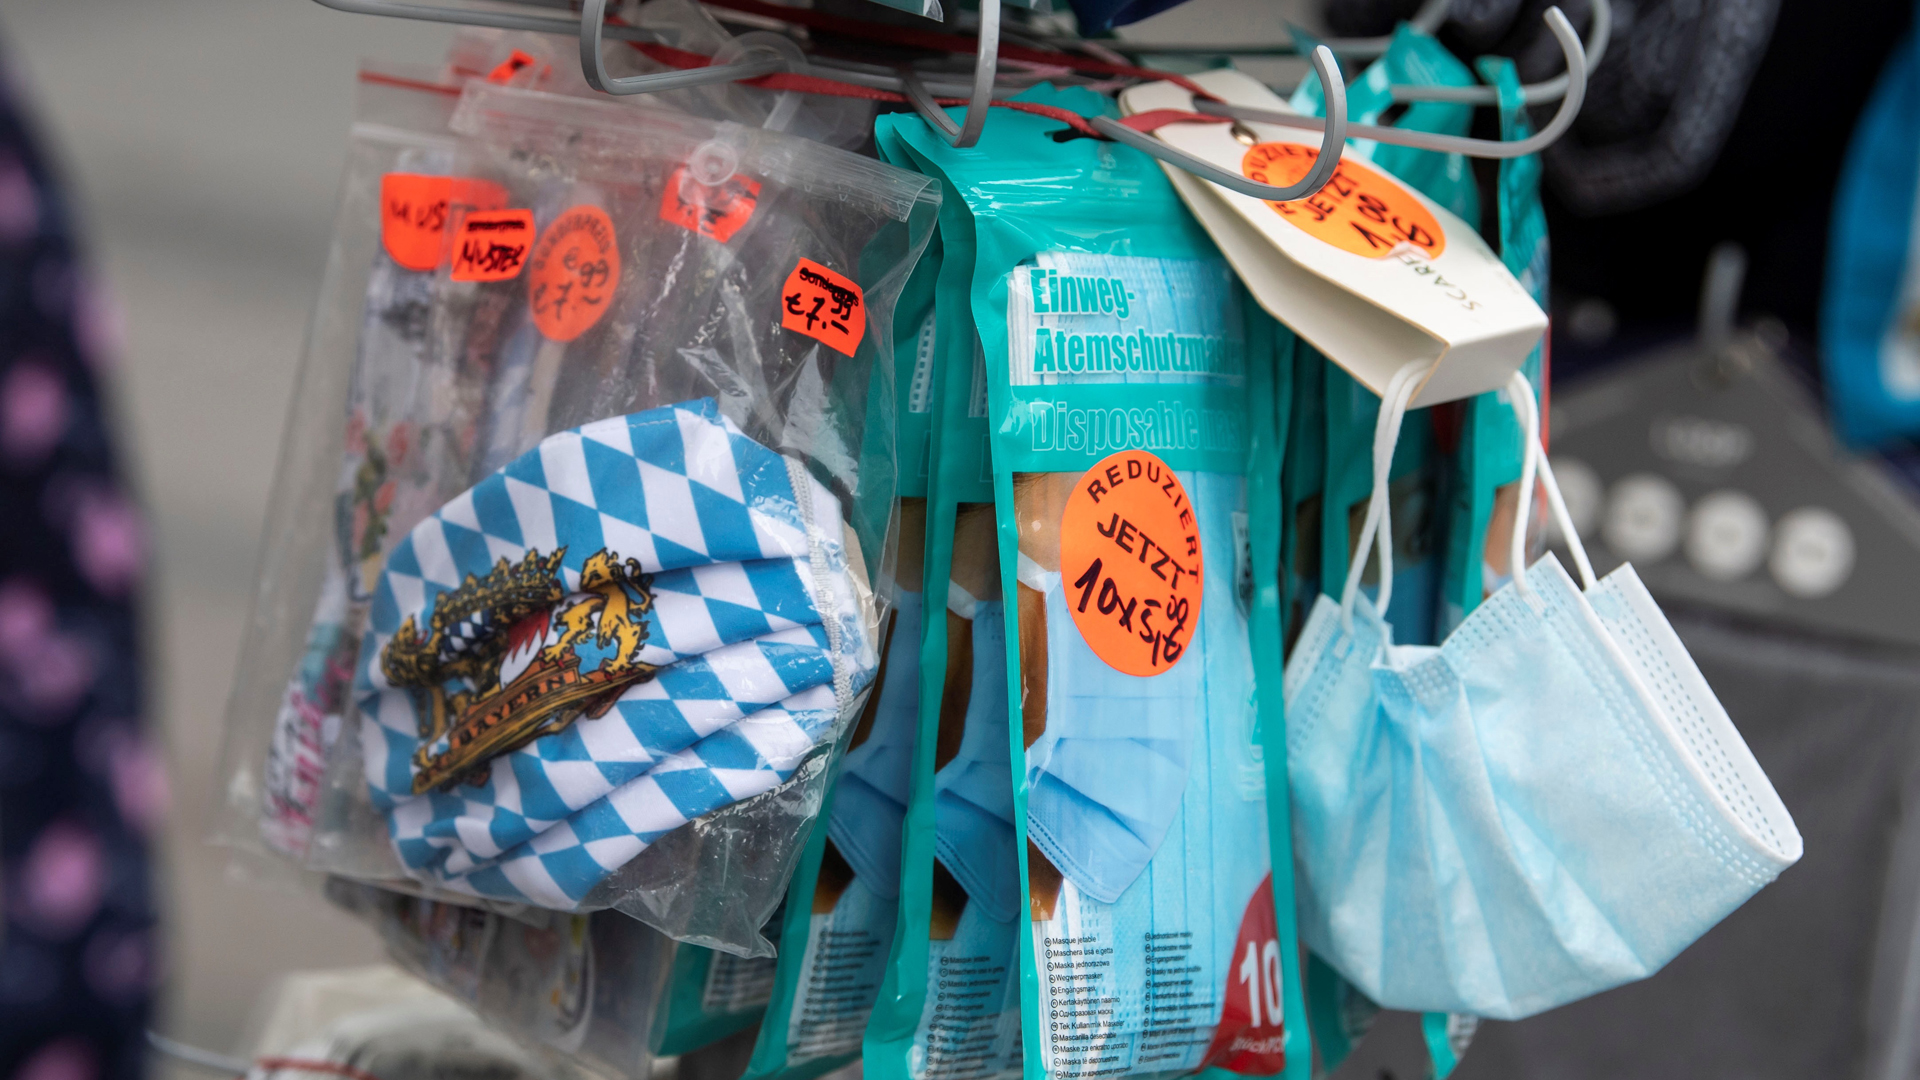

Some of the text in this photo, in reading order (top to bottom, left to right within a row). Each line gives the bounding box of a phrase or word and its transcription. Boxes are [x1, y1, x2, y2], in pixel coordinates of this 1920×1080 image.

[1031, 269, 1135, 319] Einweg-
[1030, 401, 1200, 455] Disposable
[1087, 459, 1199, 585] REDUZIERT
[1096, 512, 1186, 591] JETZT
[457, 673, 567, 747] BAYERN
[1052, 937, 1077, 946] Masque
[1053, 949, 1083, 957] Maschera
[1054, 961, 1075, 969] Maska
[1055, 972, 1103, 982] Wegwerpmasker
[1239, 939, 1284, 1028] 10
[1059, 1022, 1071, 1030] Tek
[1059, 1033, 1089, 1042] Mascarilla
[1060, 1045, 1080, 1053] Maske
[1061, 1057, 1081, 1065] Maska
